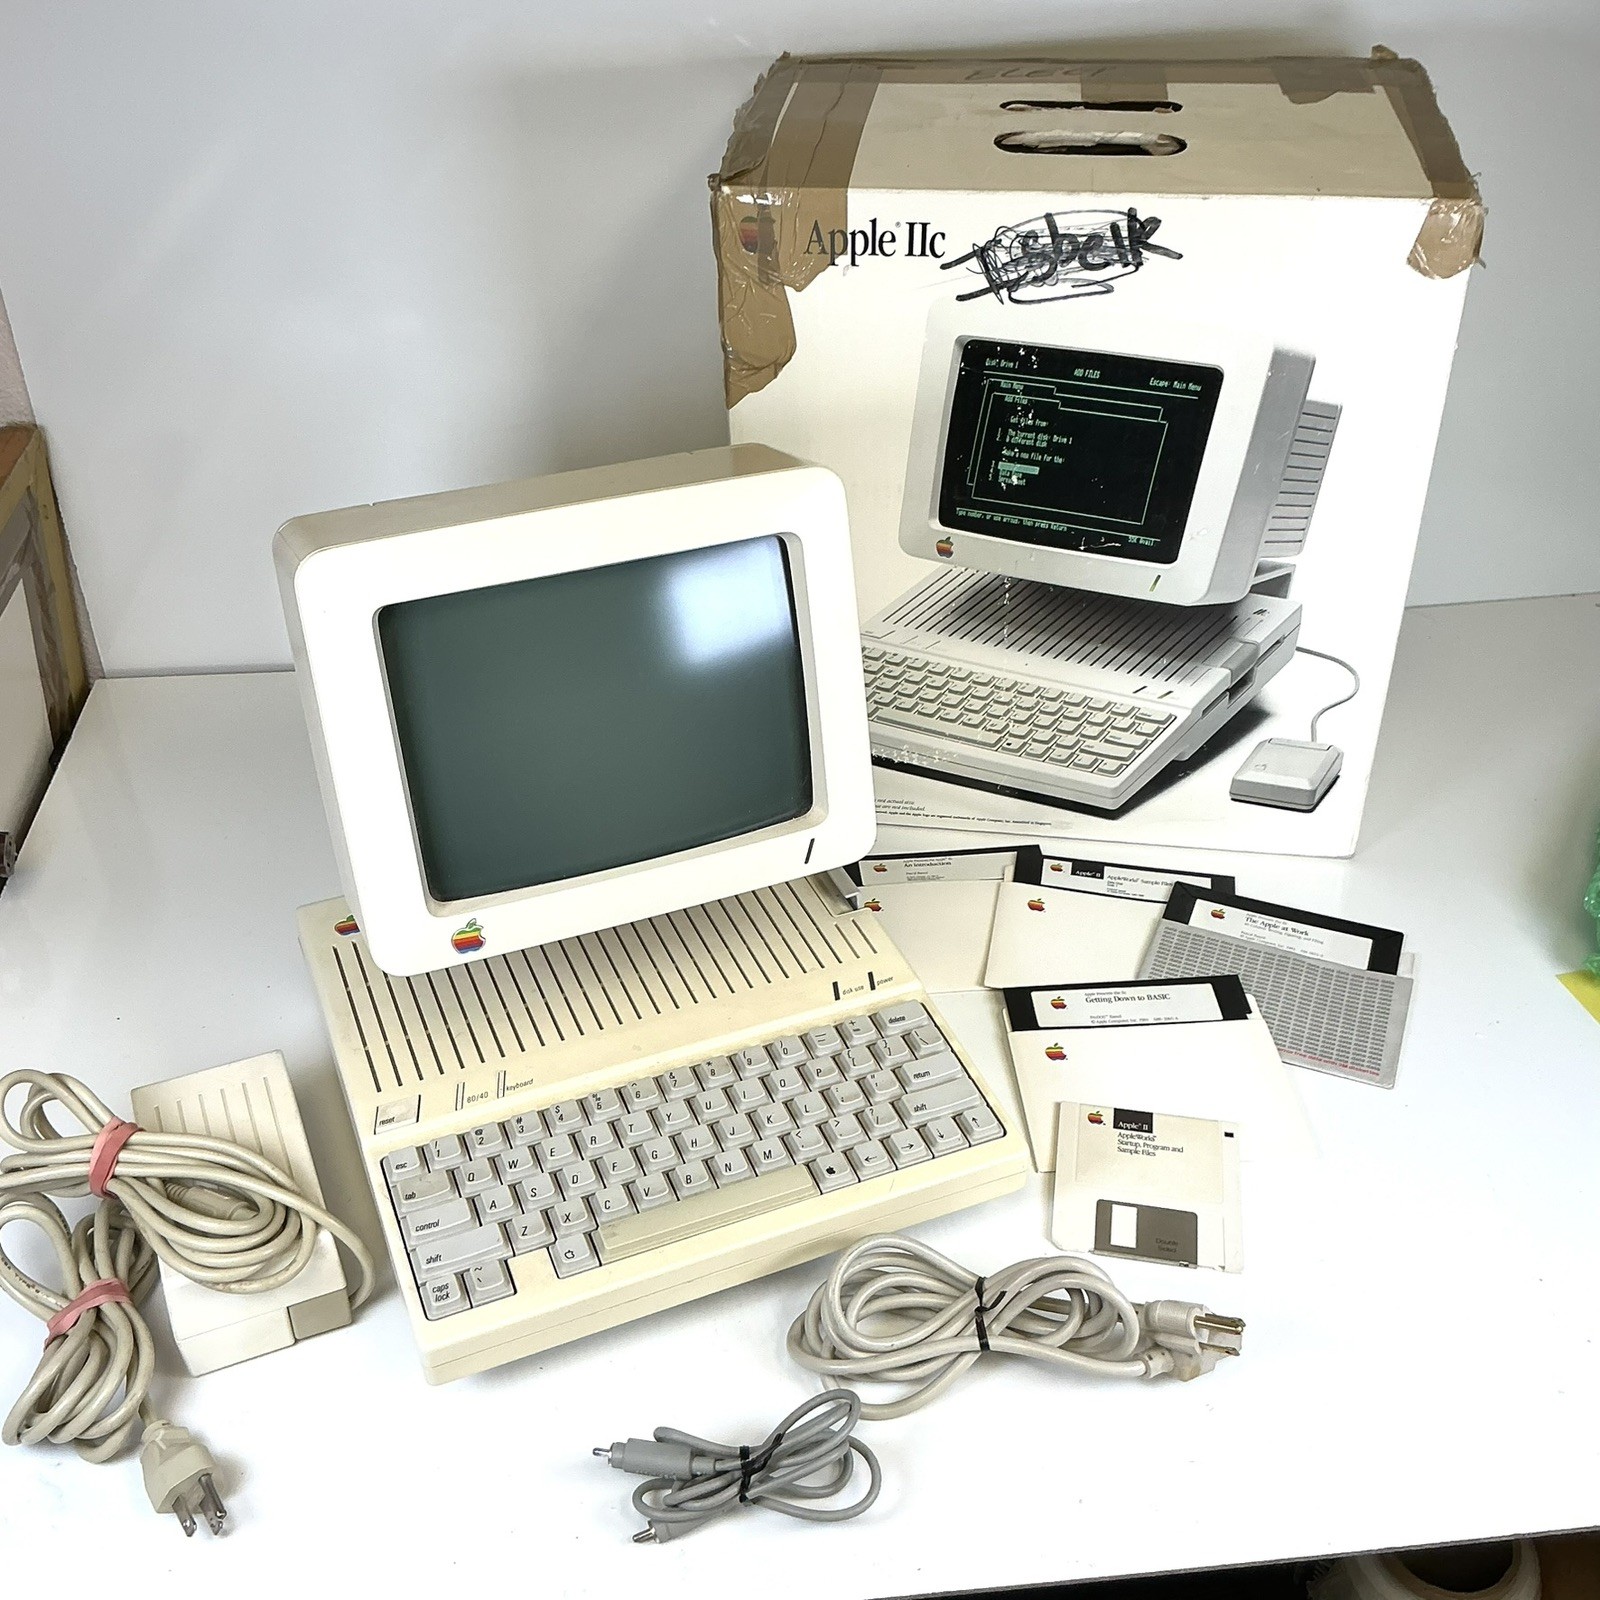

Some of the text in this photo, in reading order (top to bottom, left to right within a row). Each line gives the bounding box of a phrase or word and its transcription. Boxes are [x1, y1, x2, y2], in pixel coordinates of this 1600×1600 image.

[905, 221, 946, 258] IIc
[1085, 369, 1101, 379] FILES
[1260, 921, 1280, 930] Apple
[876, 975, 894, 988] power
[1085, 996, 1113, 1005] Getting
[1113, 995, 1136, 1003] Down
[888, 1015, 906, 1023] delete
[783, 1046, 788, 1055] 0
[746, 1057, 753, 1066] 9
[710, 1068, 716, 1076] 8
[816, 1068, 822, 1076] P
[913, 1069, 931, 1079] return
[506, 1078, 534, 1092] keyboard
[672, 1079, 678, 1088] 7
[780, 1078, 786, 1088] O
[466, 1091, 489, 1104] 80/40
[635, 1090, 641, 1099] 6
[596, 1101, 603, 1110] 5
[705, 1101, 712, 1110] U
[804, 1103, 809, 1112] L
[914, 1102, 927, 1113] shift
[379, 1116, 395, 1126] reset
[558, 1113, 564, 1121] 4
[665, 1112, 672, 1121] Y
[767, 1114, 774, 1124] K
[518, 1124, 525, 1134] 3
[628, 1124, 634, 1133] T
[729, 1126, 735, 1136] J
[478, 1136, 485, 1145] 2
[590, 1136, 597, 1145] R
[691, 1138, 698, 1148] H
[1117, 1146, 1156, 1157] Sample Files
[1143, 1142, 1170, 1151] Program
[550, 1147, 556, 1157] E
[651, 1150, 658, 1159] G
[763, 1149, 772, 1160] M
[395, 1161, 408, 1170] esc
[508, 1160, 518, 1169] W
[612, 1162, 618, 1171] F
[725, 1162, 732, 1172] N
[572, 1175, 579, 1184] D
[685, 1174, 692, 1184] B
[404, 1191, 416, 1200] tab
[530, 1187, 537, 1198] S
[644, 1187, 650, 1198] V
[489, 1200, 497, 1210] A
[604, 1200, 611, 1210] C
[563, 1213, 572, 1223] X
[415, 1219, 440, 1232] control
[521, 1226, 528, 1236] Z
[425, 1254, 442, 1265] shift
[432, 1282, 449, 1294] caps
[434, 1291, 451, 1302] lock
